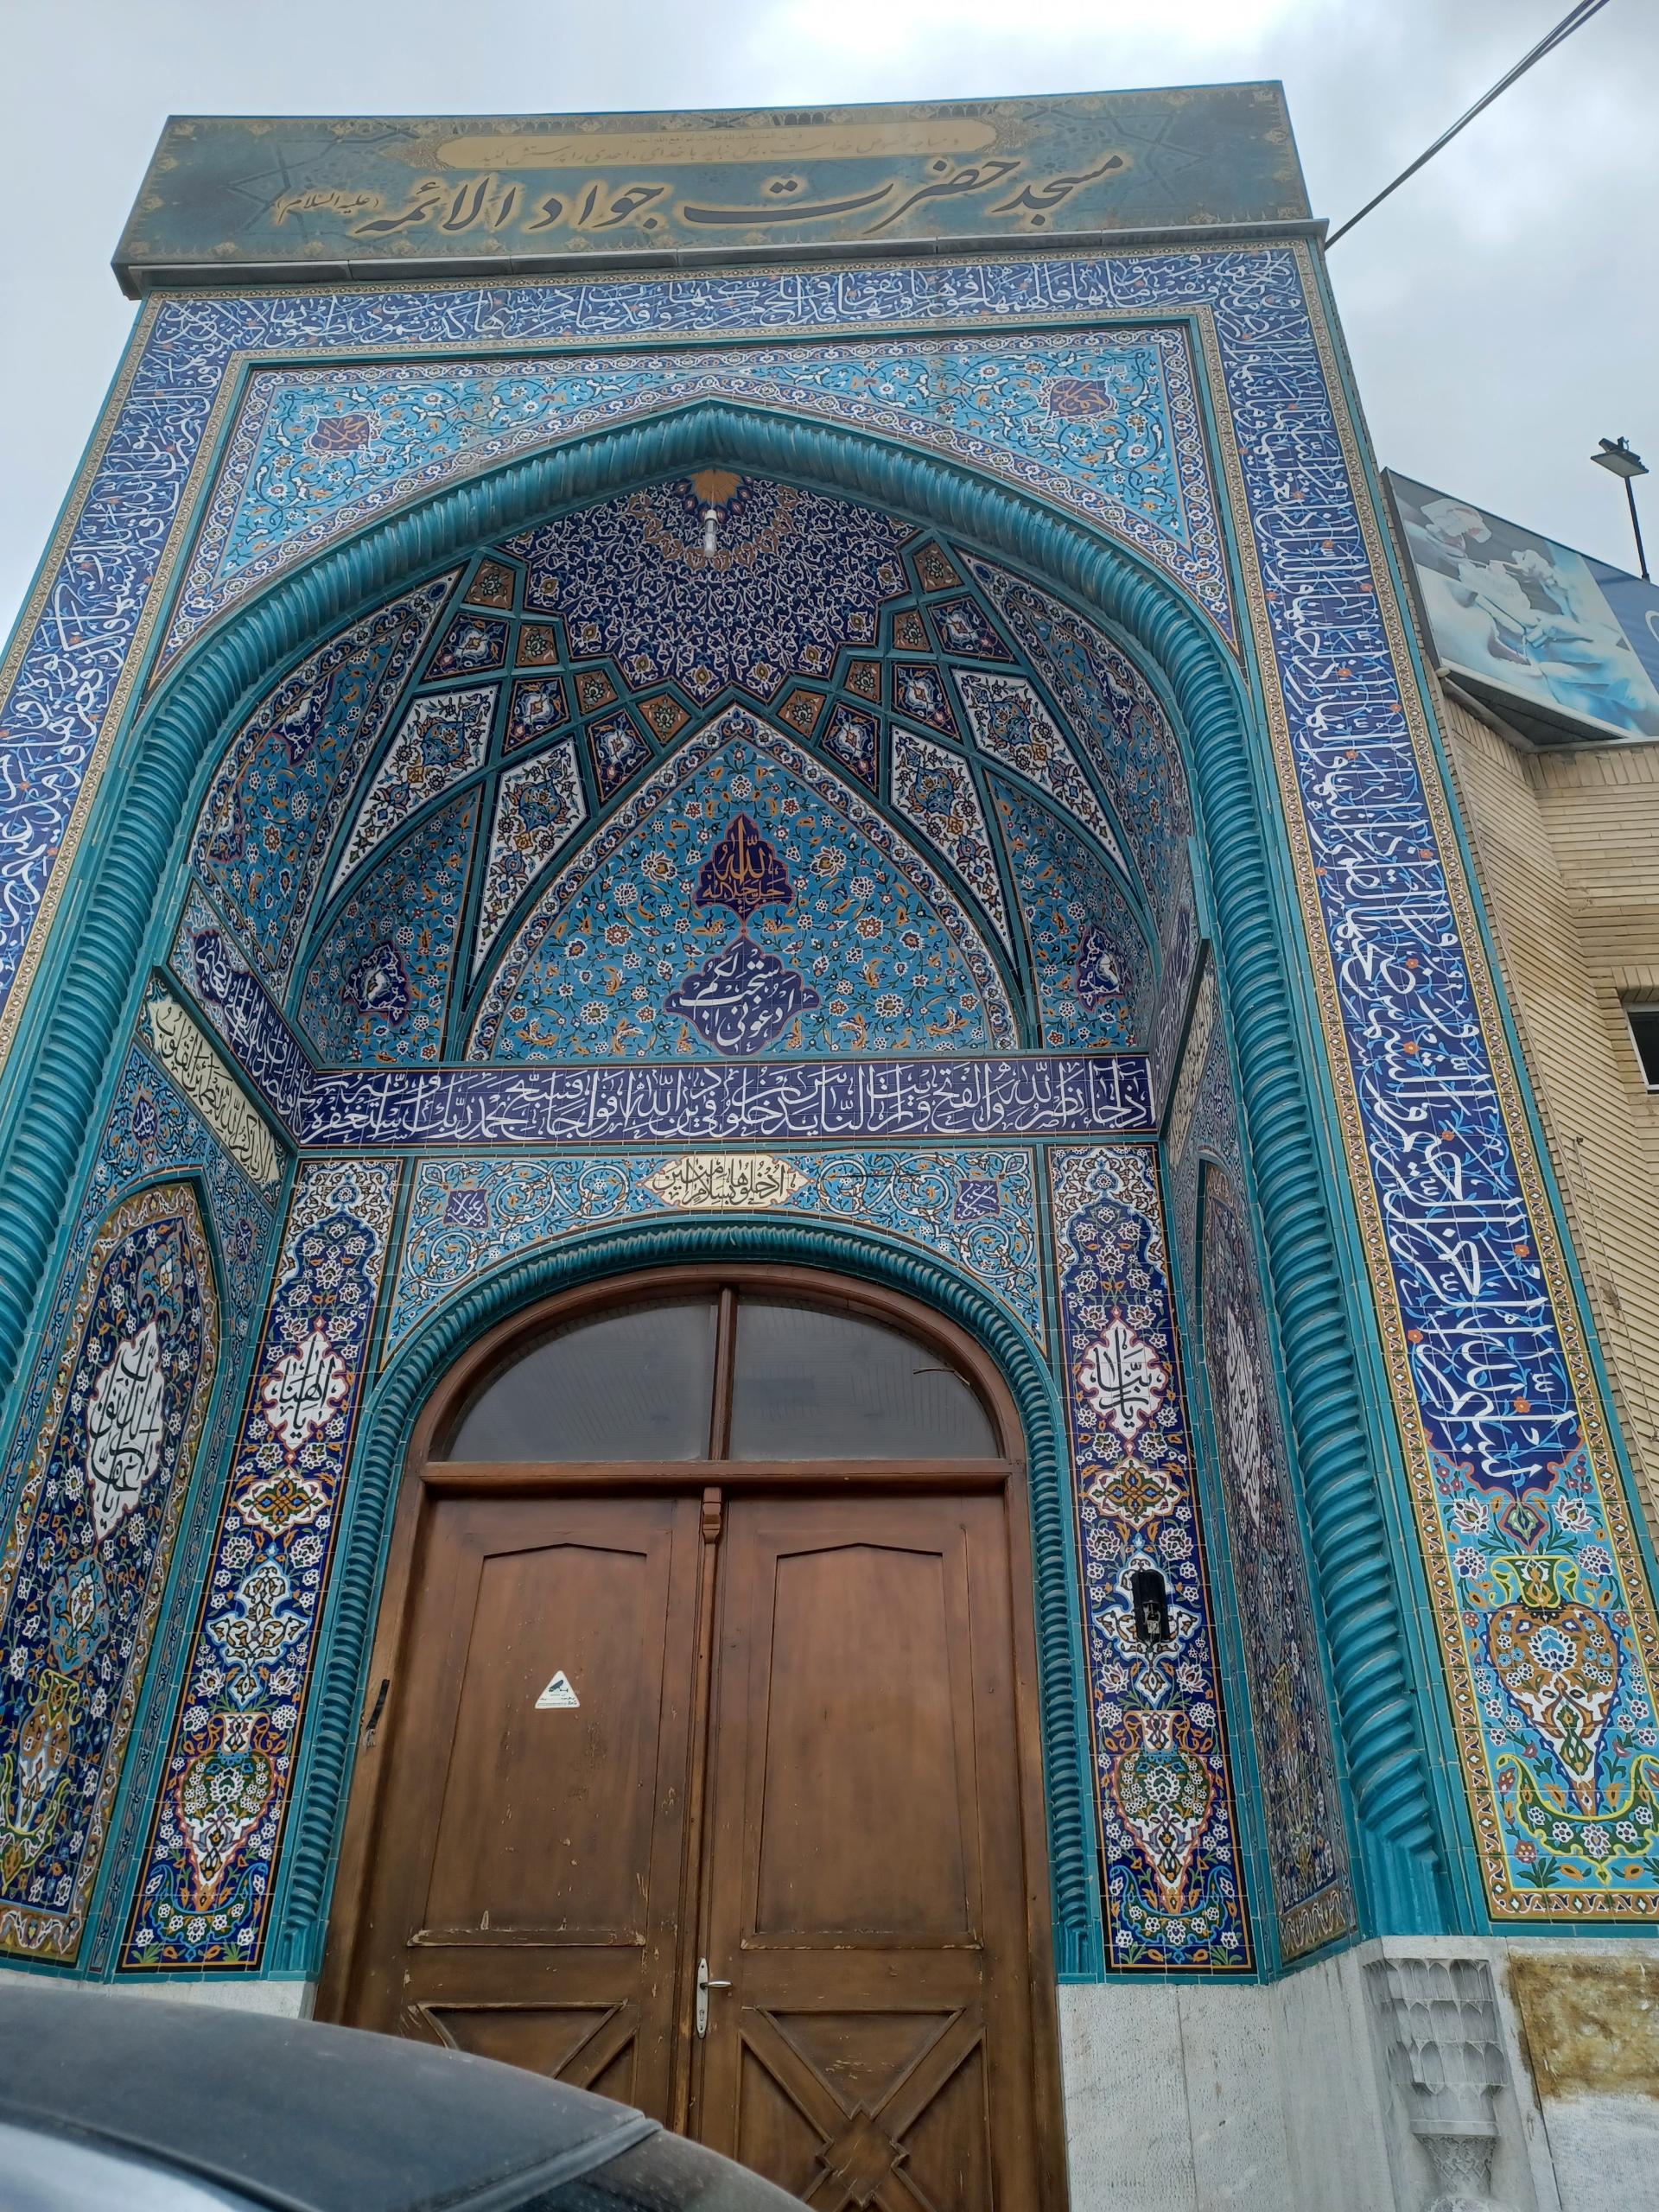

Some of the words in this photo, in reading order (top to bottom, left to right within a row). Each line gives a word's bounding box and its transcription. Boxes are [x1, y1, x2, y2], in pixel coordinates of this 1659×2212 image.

[528, 181, 665, 230] جواد
[683, 160, 1022, 235] حضرت
[994, 155, 1123, 226] مسجد
